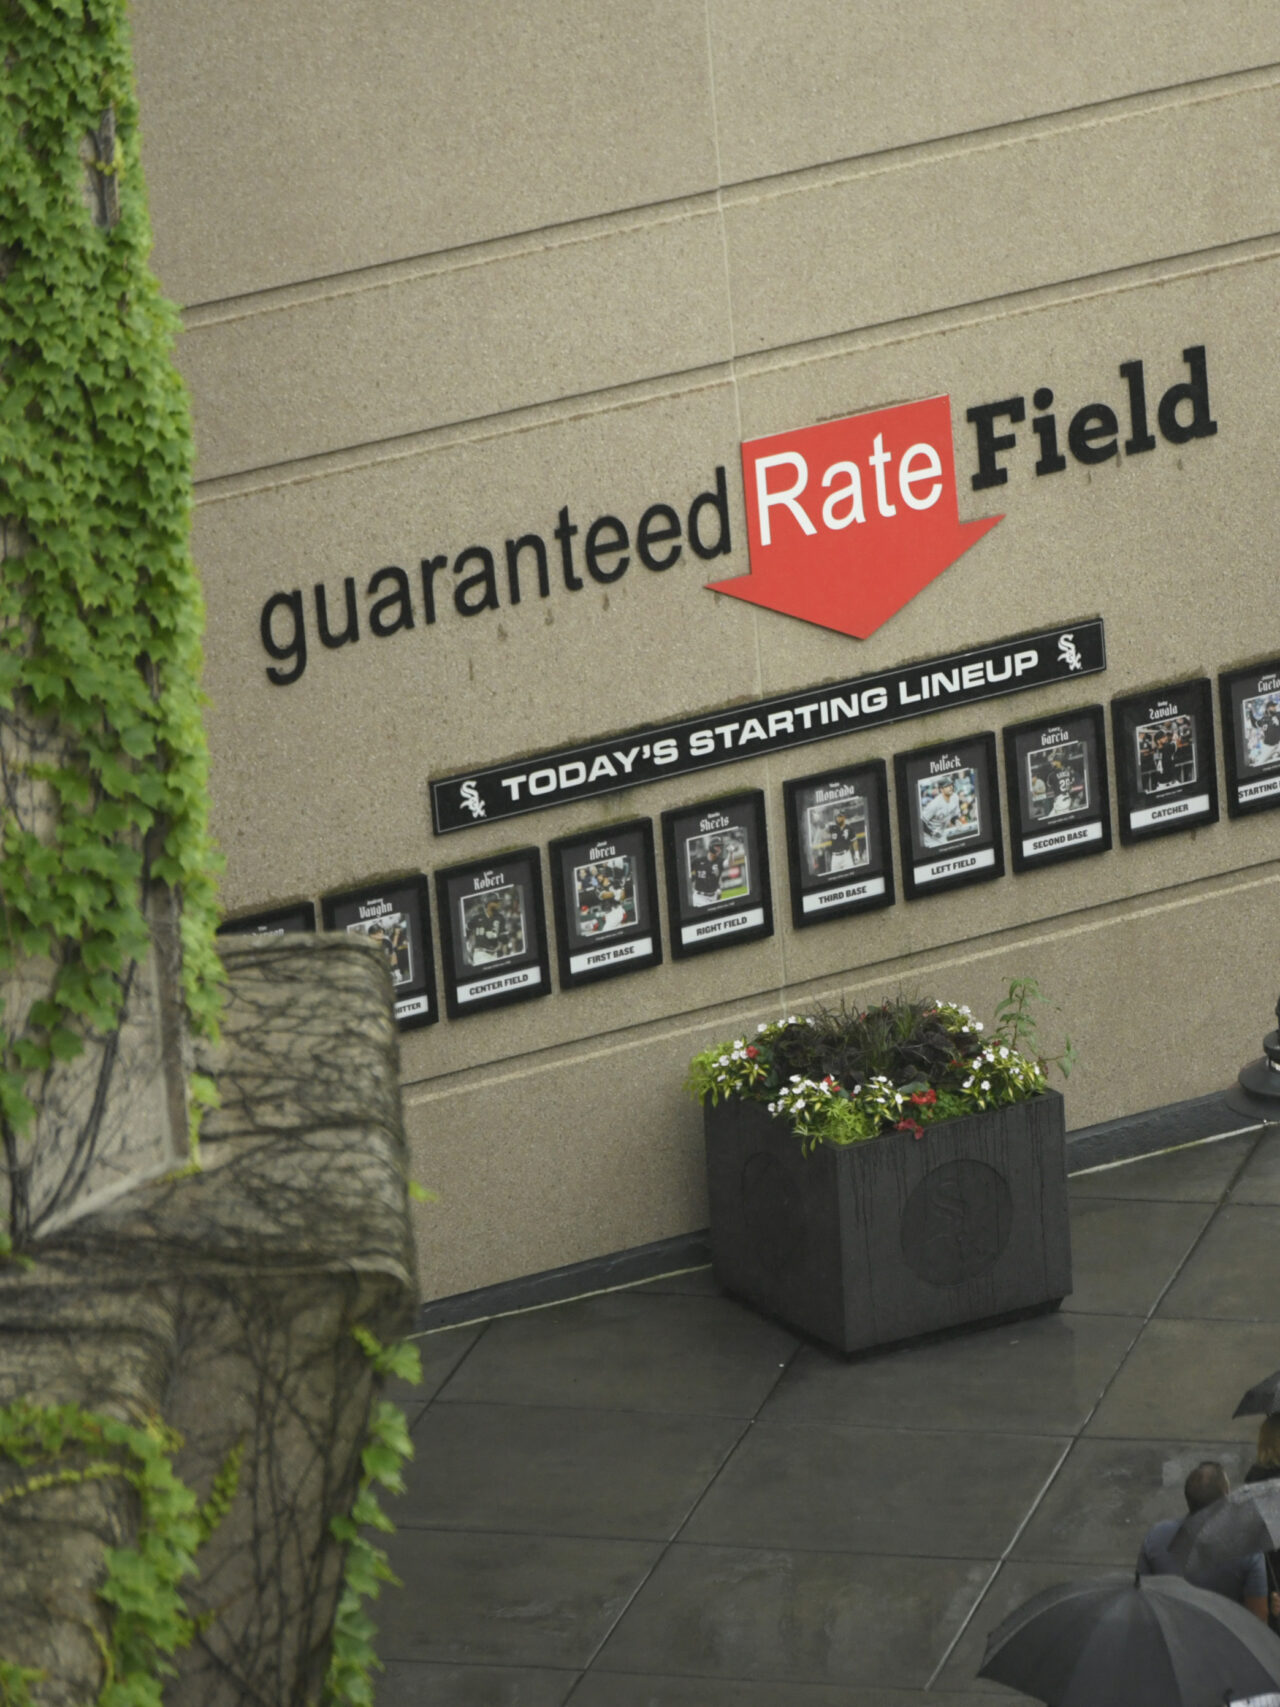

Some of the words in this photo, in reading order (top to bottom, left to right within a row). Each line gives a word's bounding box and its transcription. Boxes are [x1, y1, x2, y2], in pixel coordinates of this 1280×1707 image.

[260, 466, 732, 686] guaranteed
[755, 432, 943, 546] Rate
[967, 345, 1218, 491] Field
[1148, 704, 1178, 720] Zavala
[501, 738, 679, 800] TODAY'S
[689, 687, 888, 756] STARTING
[899, 649, 1039, 705] LINEUP
[929, 755, 961, 774] Pollock
[815, 785, 855, 804] Moncada
[1238, 780, 1279, 799] STARTING
[1151, 803, 1189, 820] CATCHER
[700, 816, 730, 832] Sheets
[1033, 834, 1066, 850] SECOND
[1066, 829, 1088, 843] BASE
[589, 845, 616, 860] Abreu
[931, 862, 951, 876] LEFT
[952, 857, 976, 870] FIELD
[473, 872, 505, 891] Robert
[818, 891, 845, 905] THIRD
[845, 885, 867, 899] BASE
[358, 901, 393, 919] Vaughn
[696, 922, 722, 936] RIGHT
[723, 916, 747, 930] FIELD
[587, 951, 611, 965] FIRST
[612, 945, 635, 959] BASE
[469, 980, 503, 996] CENTER
[504, 974, 529, 987] FIELD
